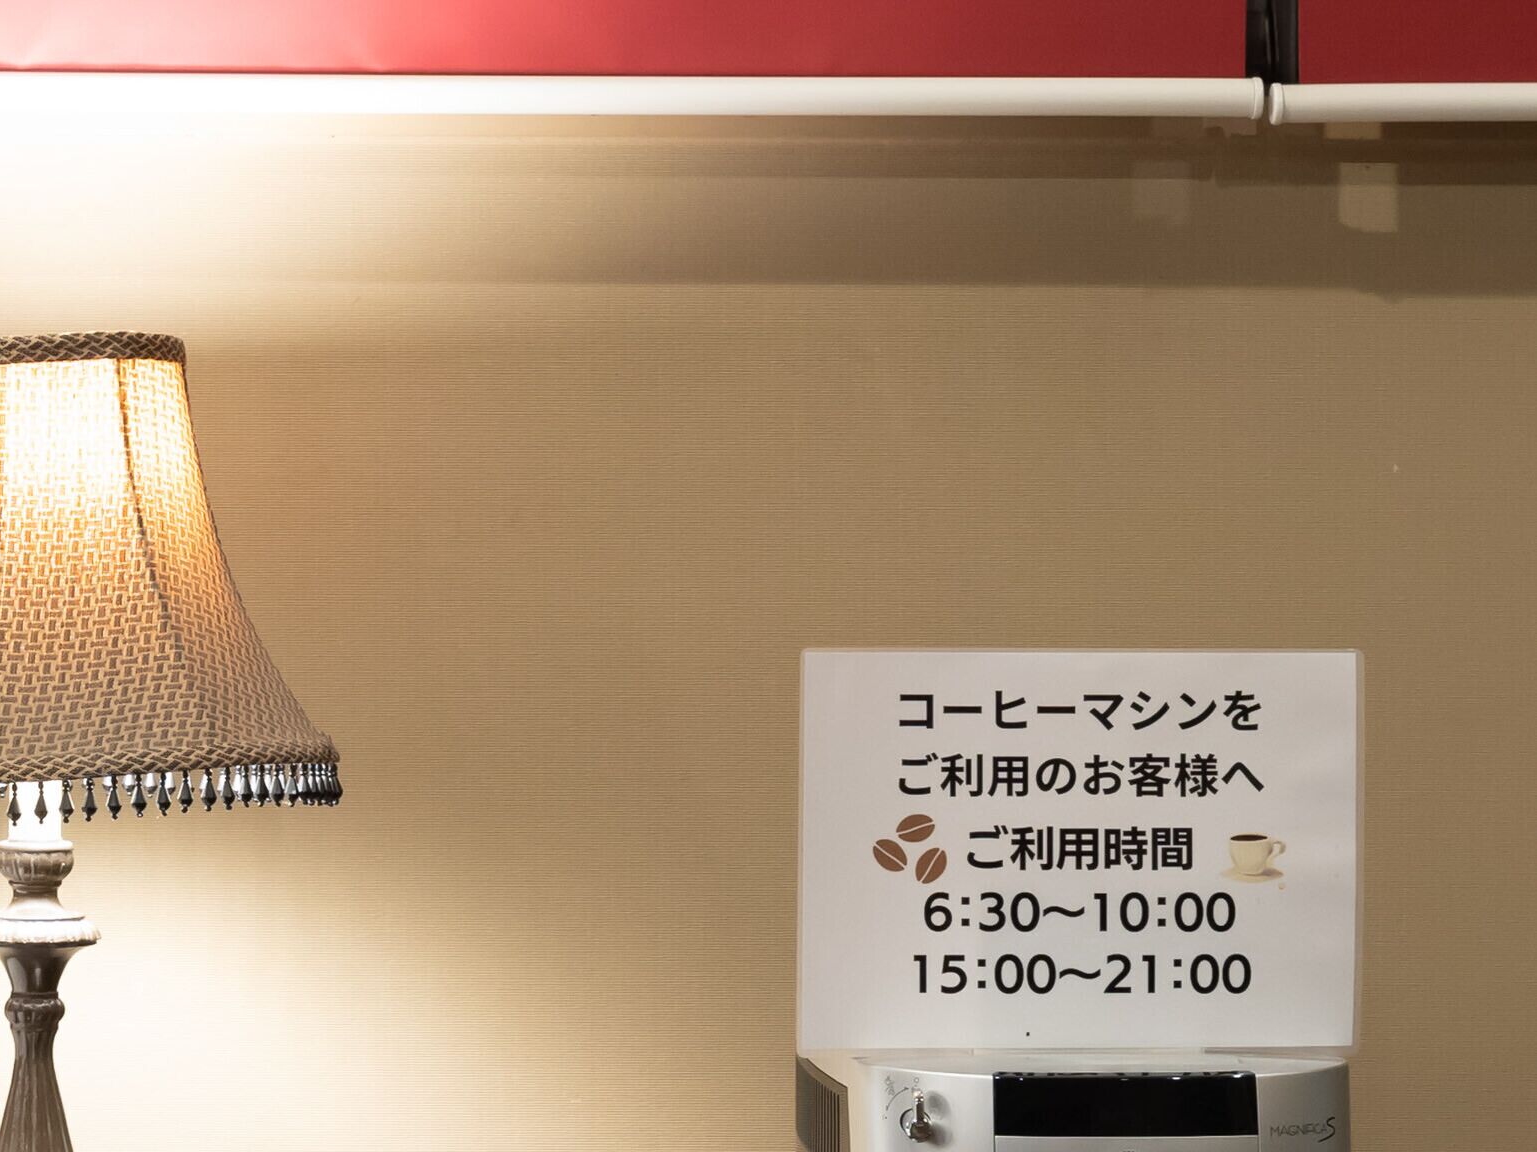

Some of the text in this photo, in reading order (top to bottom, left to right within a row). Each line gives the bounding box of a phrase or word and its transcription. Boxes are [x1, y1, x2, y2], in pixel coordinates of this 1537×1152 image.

[899, 690, 1262, 731] コーヒーマシンを
[898, 753, 1265, 798] ご利用のお客様へ
[966, 825, 1194, 871] ご利用時間
